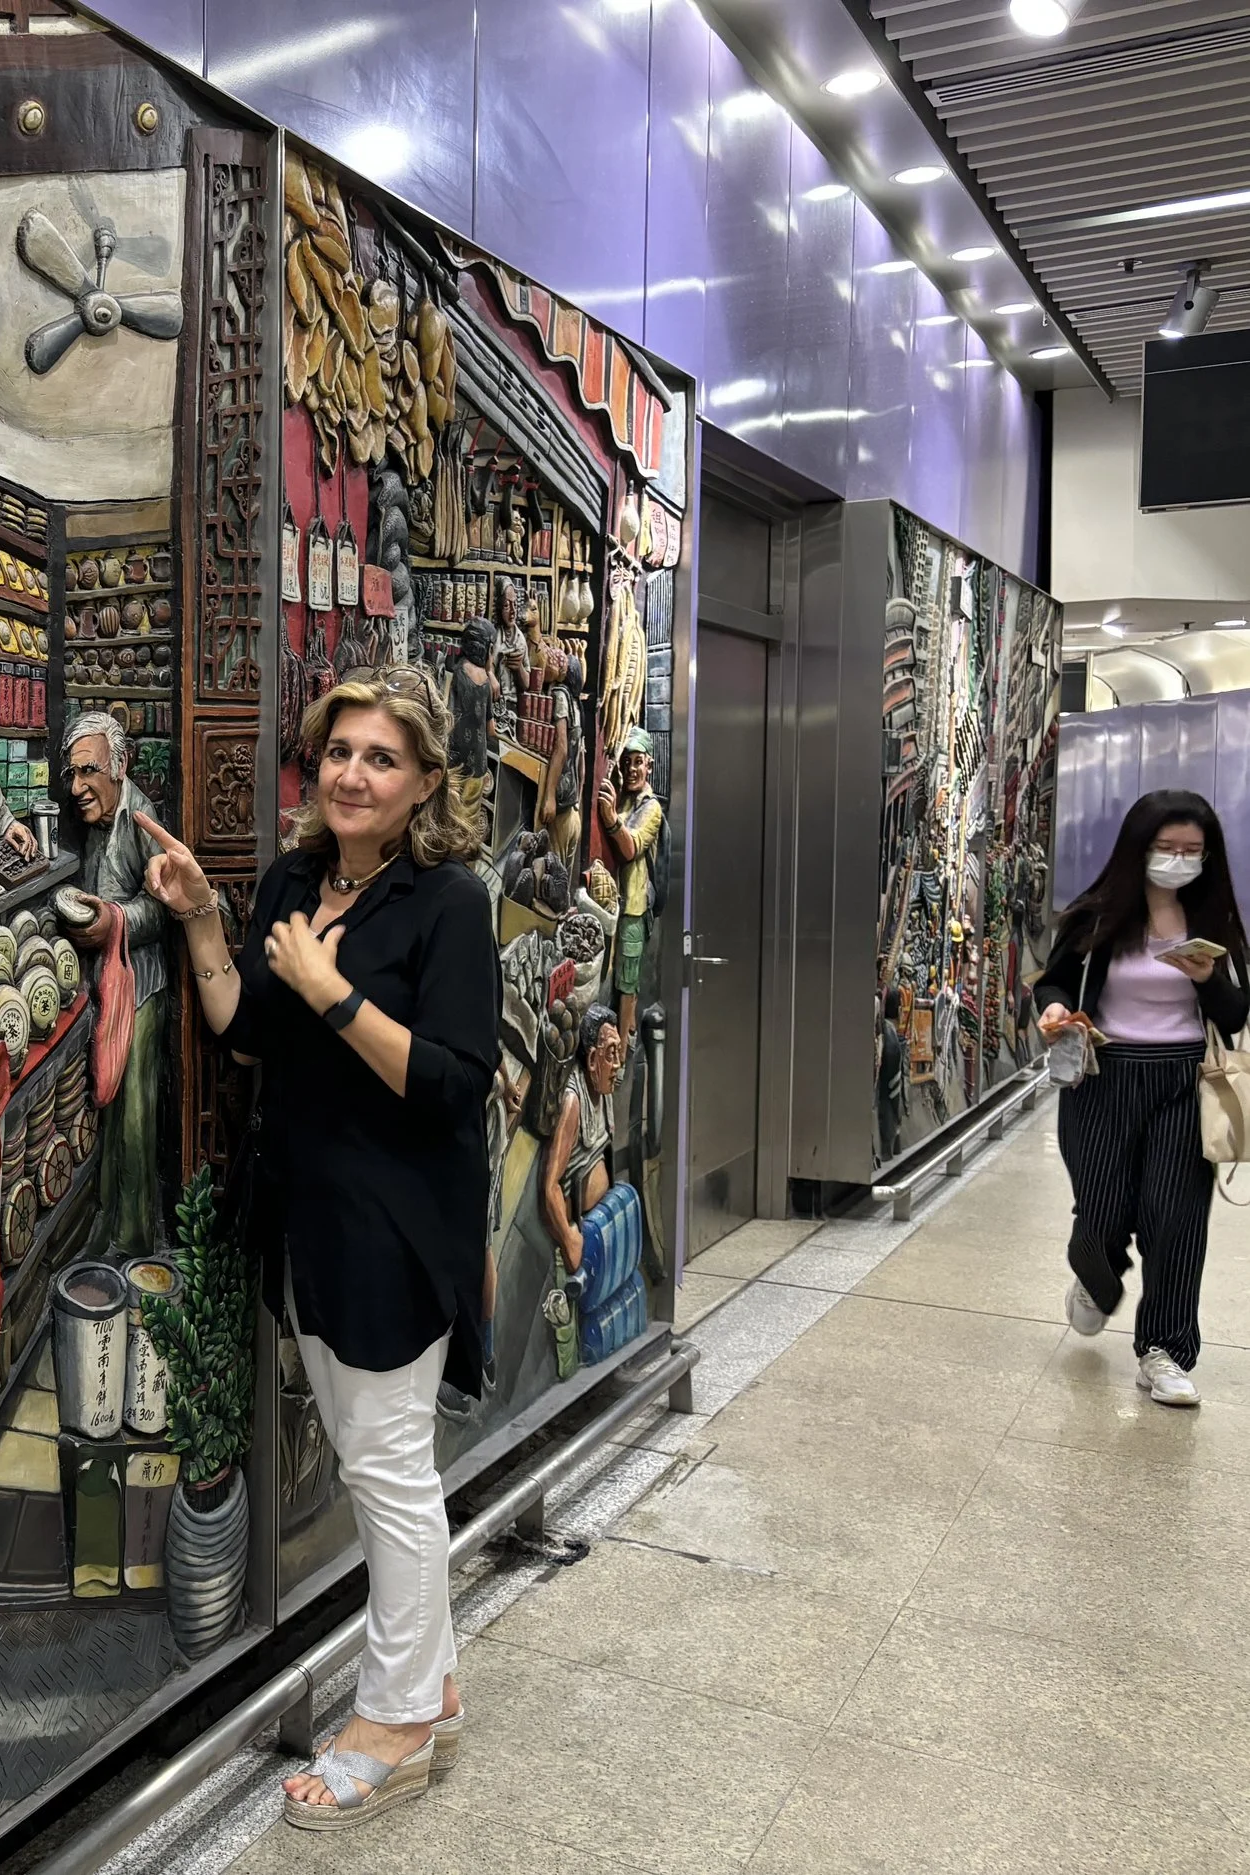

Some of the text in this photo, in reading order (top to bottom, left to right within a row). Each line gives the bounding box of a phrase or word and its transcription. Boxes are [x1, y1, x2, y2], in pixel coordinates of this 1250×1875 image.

[6, 1023, 19, 1040] 茶
[93, 1319, 114, 1335] 7100
[139, 1408, 155, 1422] 300
